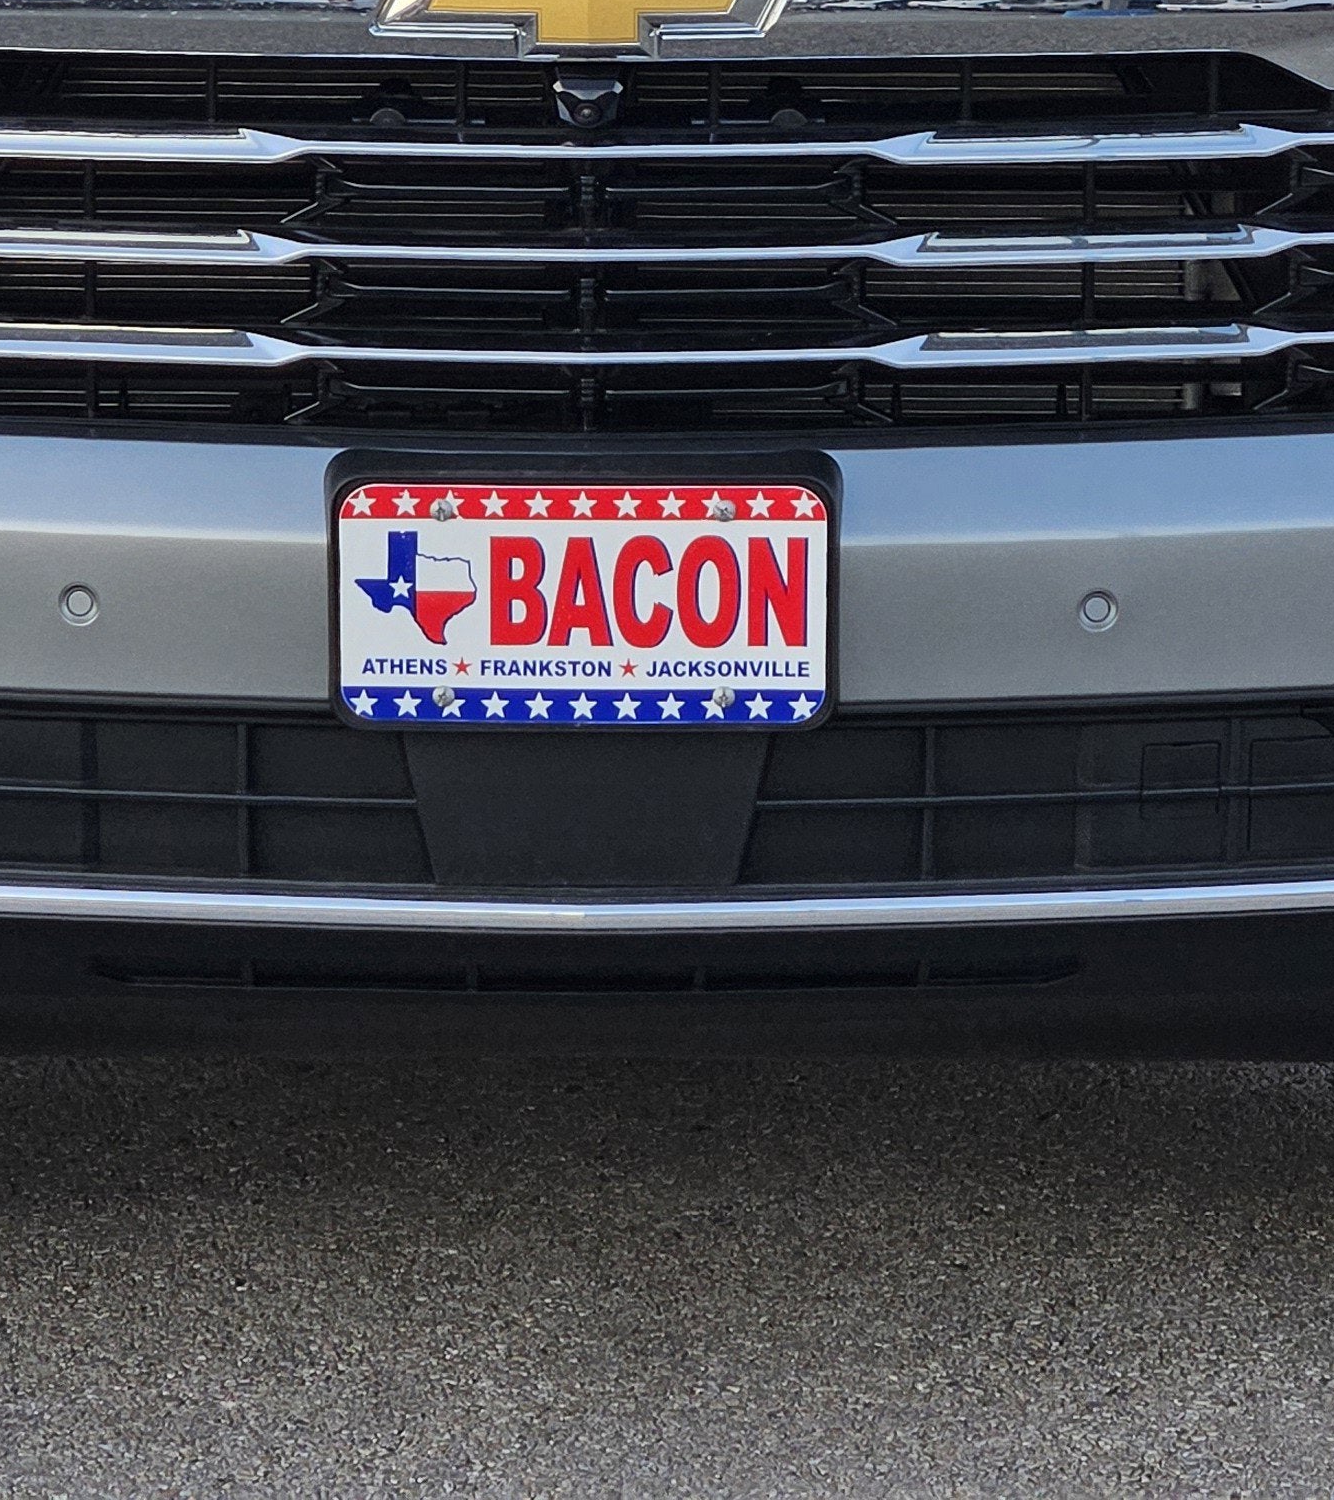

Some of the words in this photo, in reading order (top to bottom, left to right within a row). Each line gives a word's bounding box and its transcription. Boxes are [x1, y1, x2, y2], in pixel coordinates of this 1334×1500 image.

[489, 535, 810, 648] BACON
[362, 657, 448, 676] ATHENS
[480, 658, 612, 678] FRANKSTON
[646, 658, 810, 679] JACKSONVILLE
